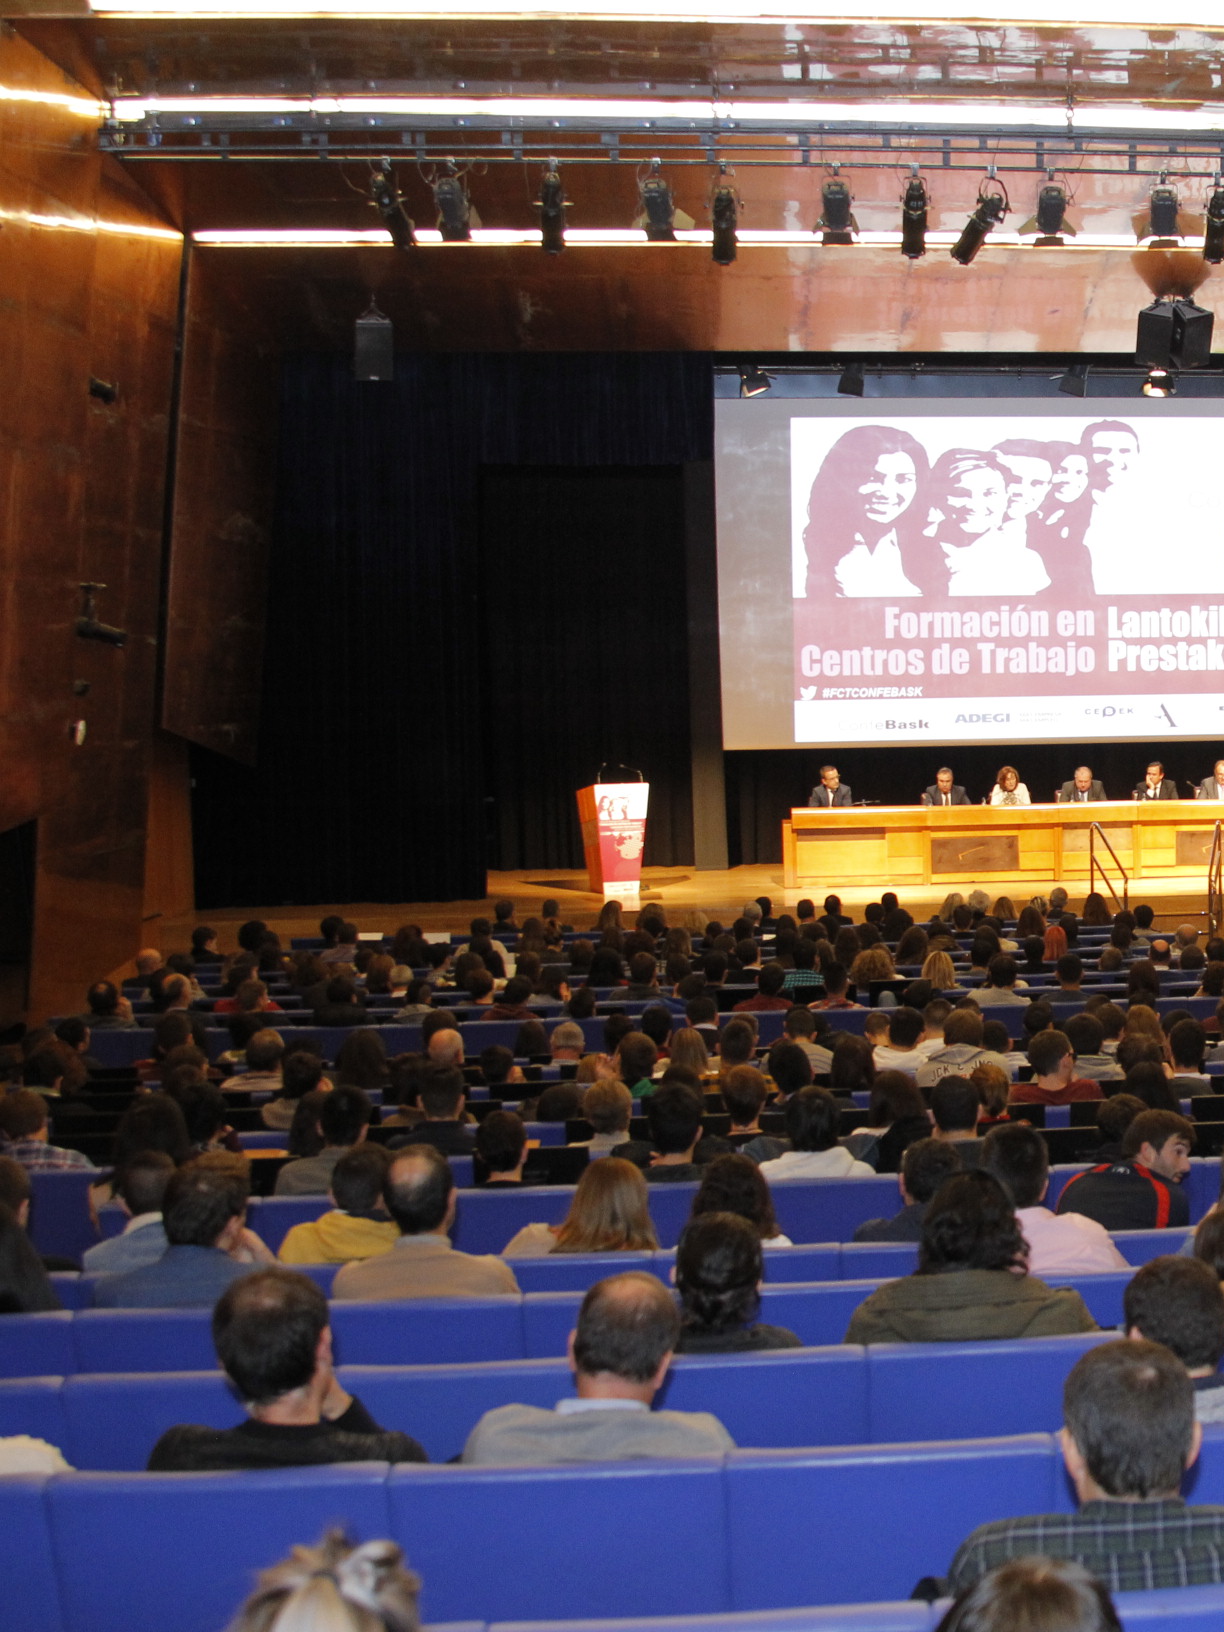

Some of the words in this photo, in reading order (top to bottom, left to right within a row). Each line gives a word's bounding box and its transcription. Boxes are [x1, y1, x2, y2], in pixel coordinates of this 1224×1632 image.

[884, 604, 1049, 639] Formación
[1056, 609, 1095, 637] en
[800, 644, 925, 677] Centros
[931, 643, 970, 675] de
[976, 641, 1095, 676] Trabajo
[822, 686, 923, 699] #FCTCONFEBASK
[955, 713, 1011, 724] ADEGI
